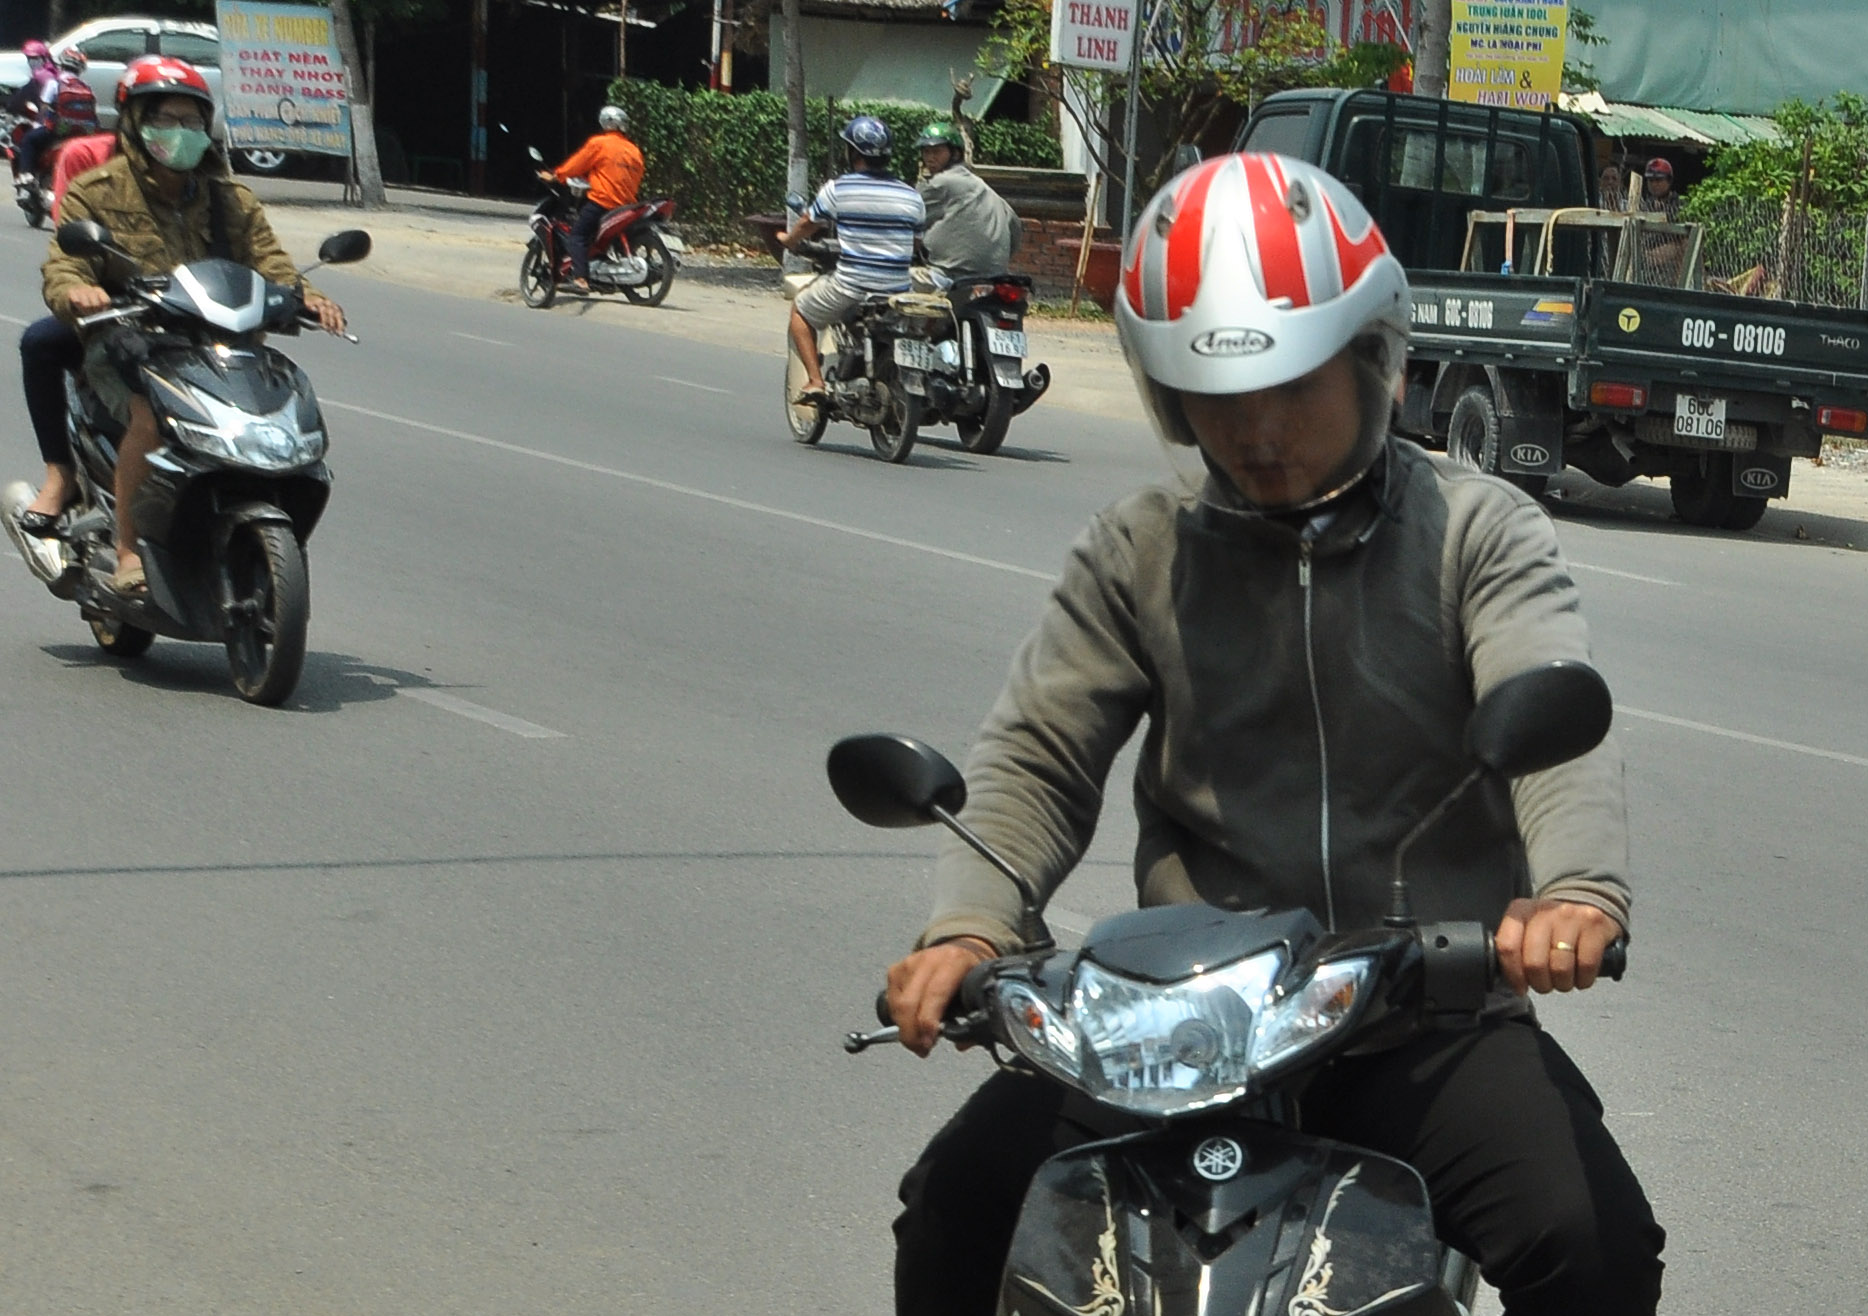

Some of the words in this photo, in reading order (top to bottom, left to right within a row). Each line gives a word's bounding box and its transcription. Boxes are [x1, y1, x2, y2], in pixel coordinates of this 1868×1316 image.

[1069, 2, 1129, 31] THANH
[1525, 25, 1558, 38] CHUNG
[1077, 35, 1118, 62] LINH
[240, 67, 285, 78] THAY
[1519, 70, 1532, 88] &
[301, 86, 346, 100] BASS
[1515, 91, 1550, 107] WON
[1418, 303, 1437, 325] NAM
[1681, 318, 1716, 348] 60C
[1733, 323, 1786, 356] 08106
[1819, 334, 1861, 349] THACO
[1687, 398, 1714, 417] 60C
[1676, 415, 1723, 437] 081.06
[1517, 447, 1543, 463] KIA
[1747, 471, 1773, 486] KIA
